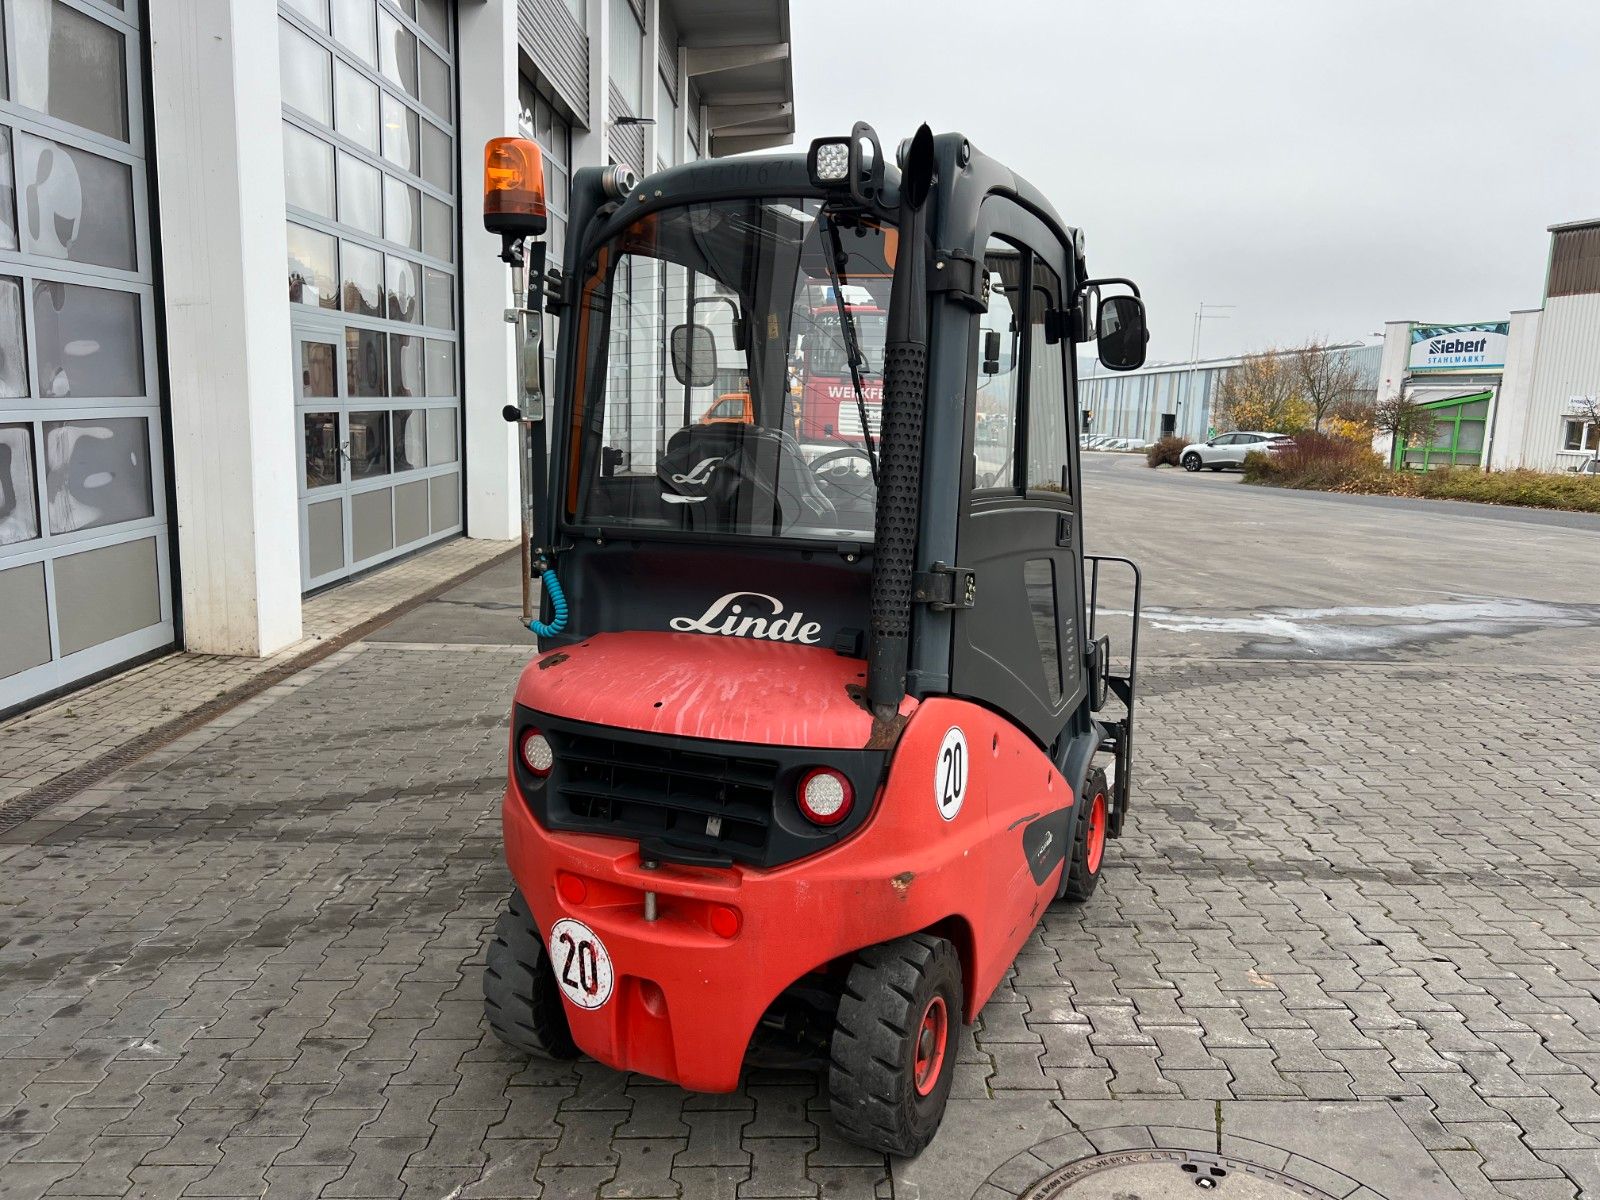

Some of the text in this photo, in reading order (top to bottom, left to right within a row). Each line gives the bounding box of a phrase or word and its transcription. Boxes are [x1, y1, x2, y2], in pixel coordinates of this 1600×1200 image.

[1428, 355, 1485, 364] STAHLMARKT
[1429, 338, 1487, 354] Siebert
[669, 591, 822, 644] Linde
[943, 742, 962, 807] 20
[560, 933, 598, 995] 20
